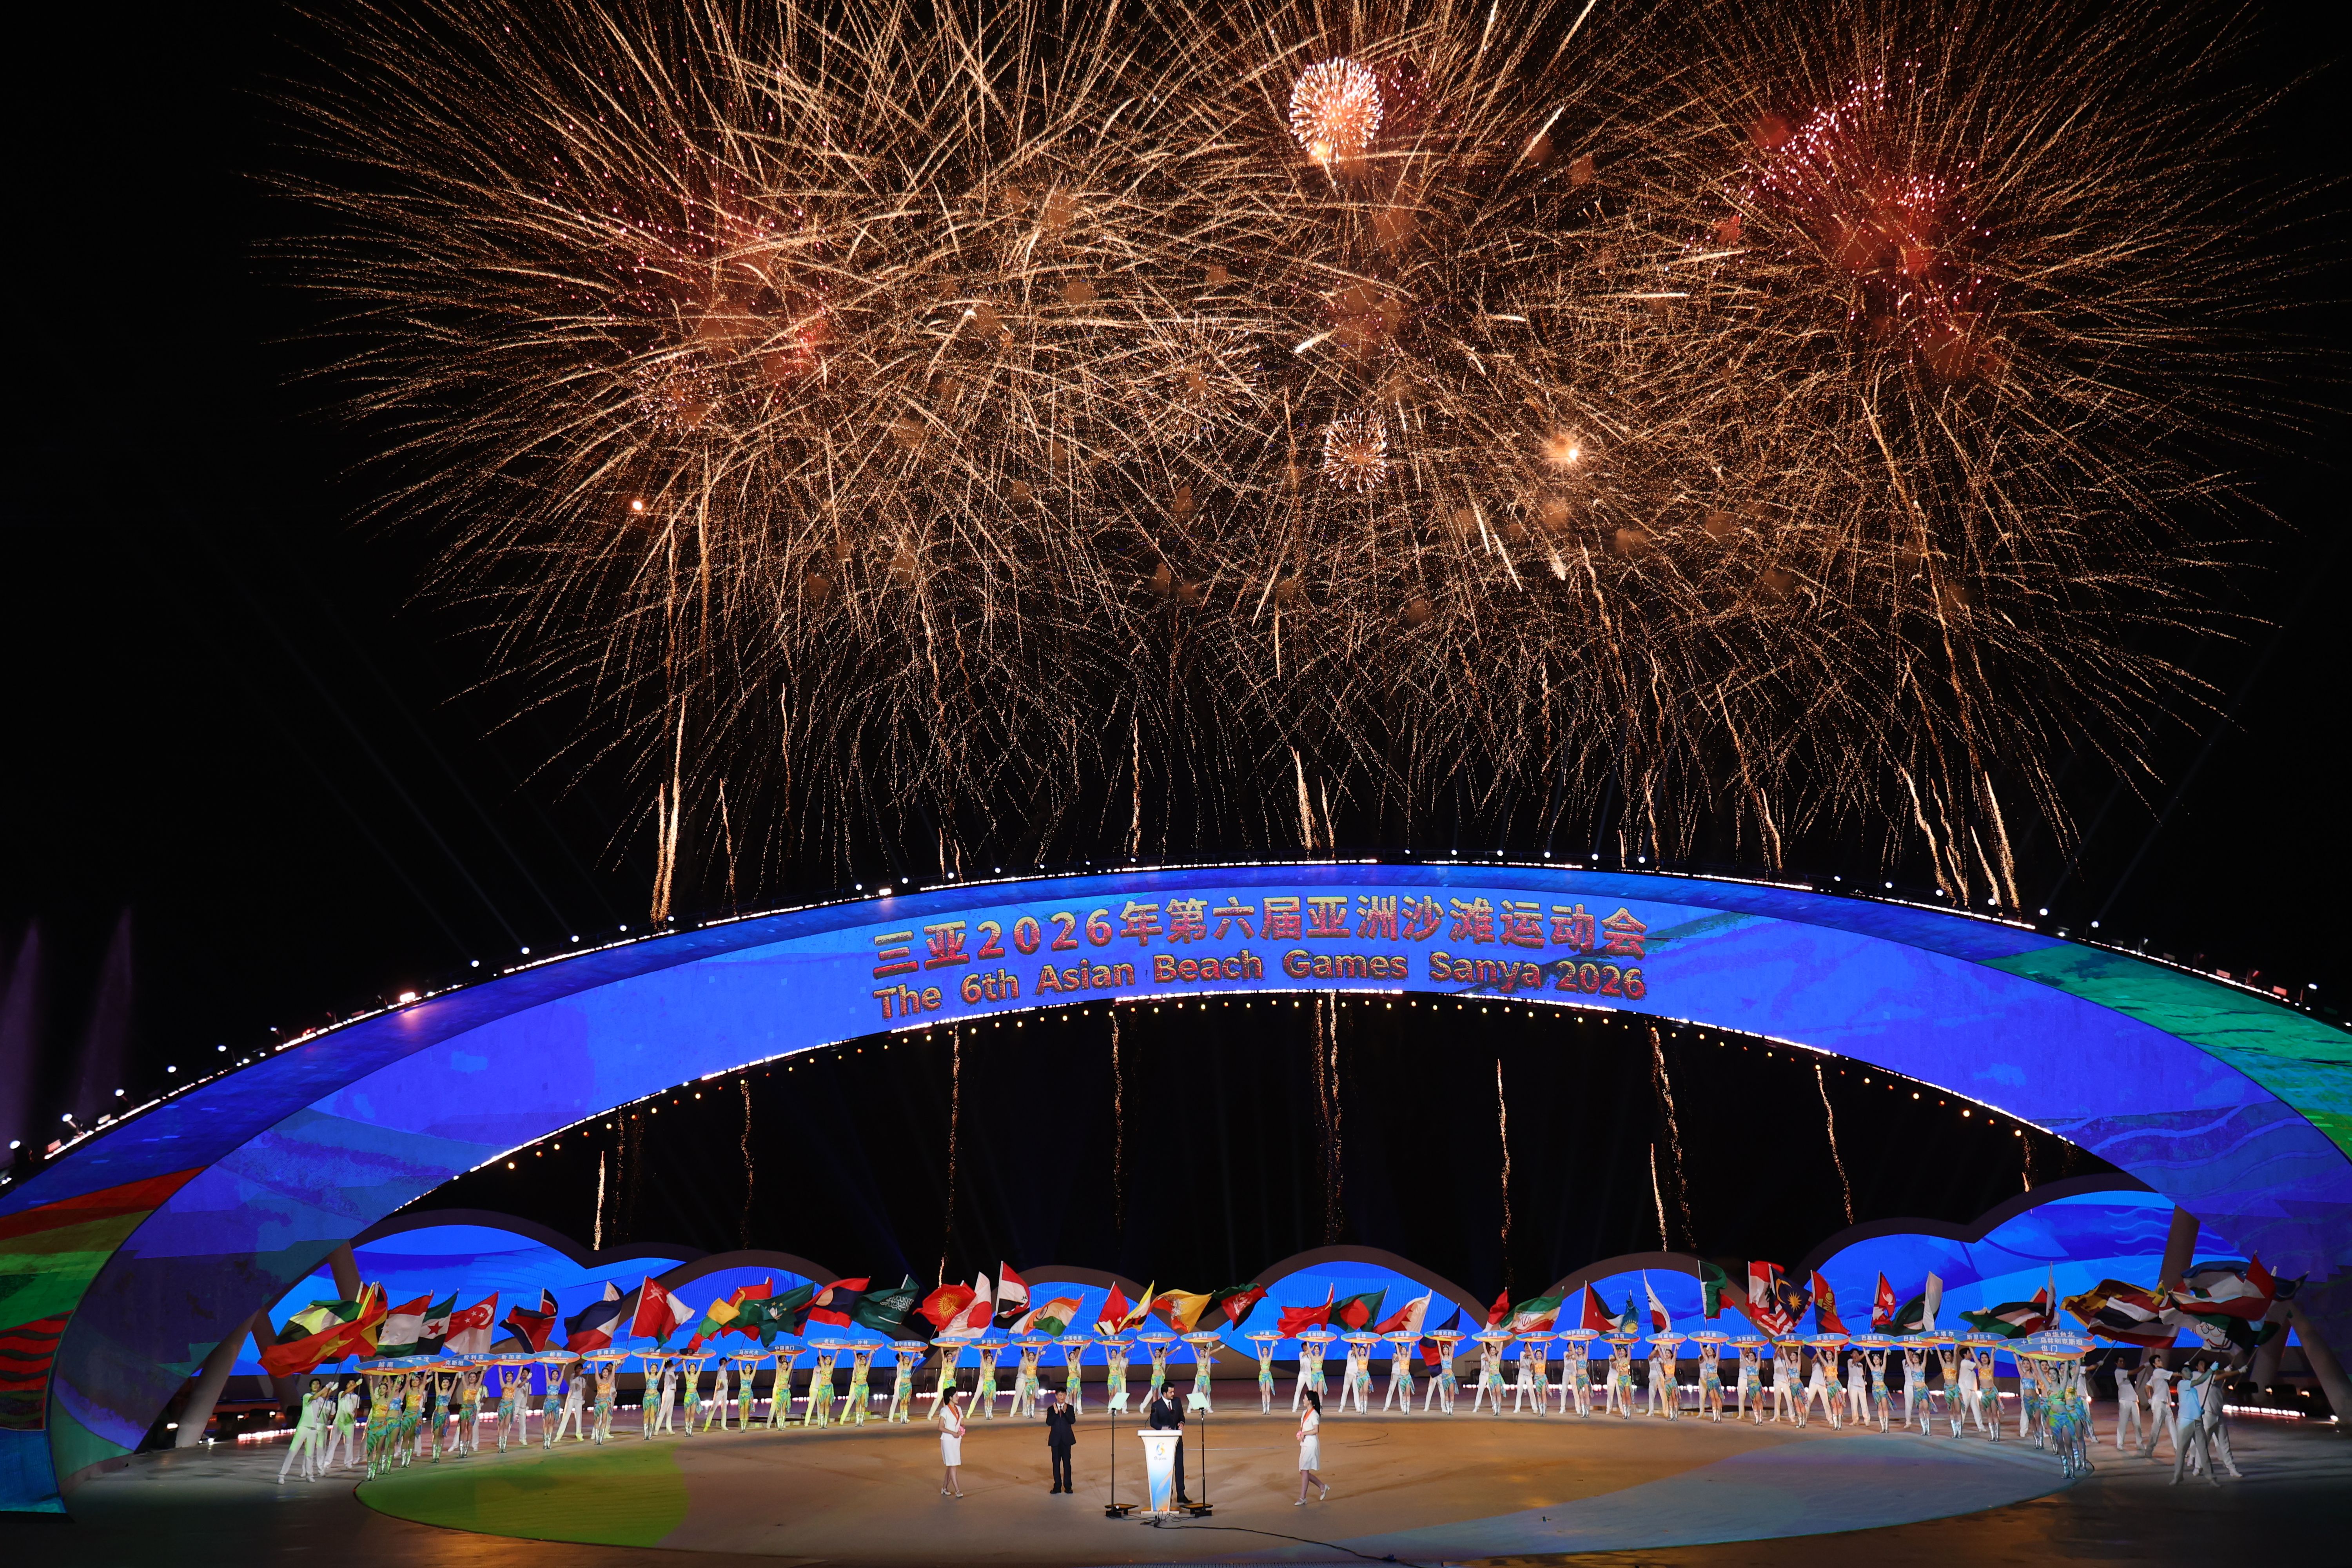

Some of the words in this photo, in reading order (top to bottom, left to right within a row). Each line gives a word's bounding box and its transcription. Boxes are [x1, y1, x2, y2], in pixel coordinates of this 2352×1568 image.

[873, 895, 1647, 979] 三亚2026年第六届亚洲沙滩运动会
[873, 984, 942, 1020] The
[960, 968, 1020, 1004] 6th
[1036, 958, 1135, 995] Asian
[1153, 949, 1263, 983] Beach
[1282, 948, 1408, 980] Games
[1430, 951, 1542, 993] Sanya
[1555, 960, 1646, 1001] 2026
[2040, 1337, 2083, 1345] 乌兹别克斯坦
